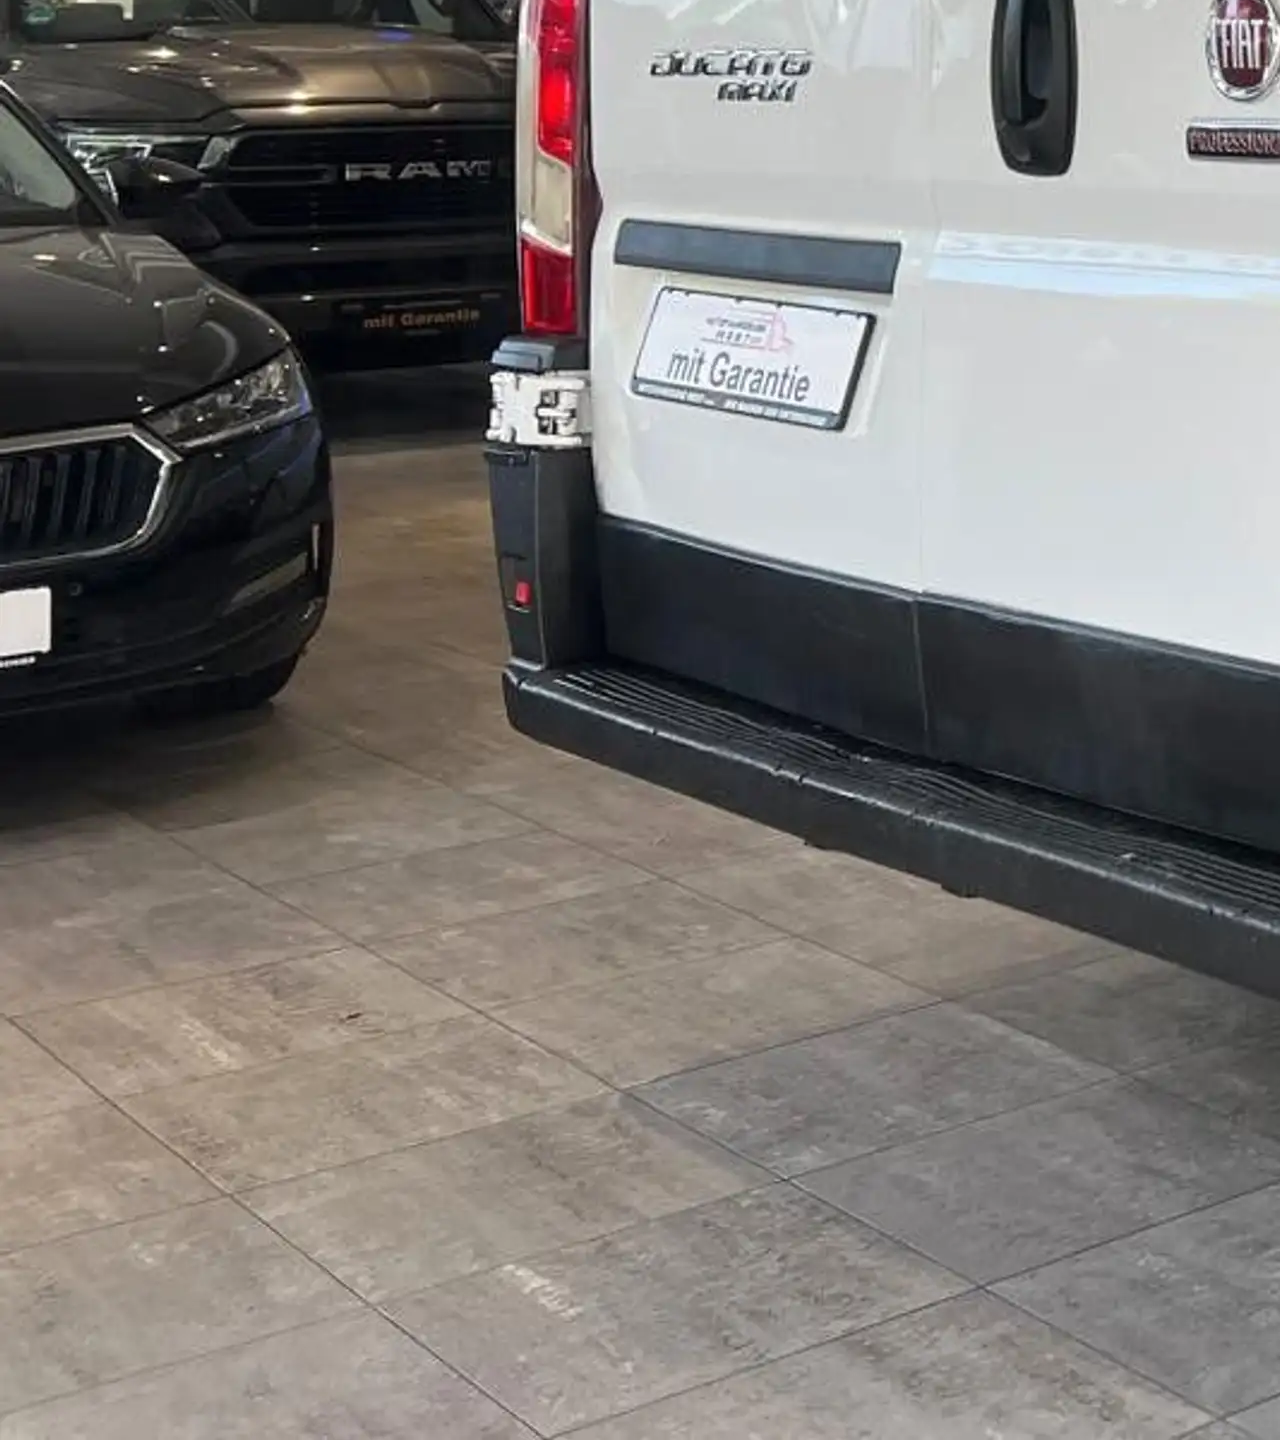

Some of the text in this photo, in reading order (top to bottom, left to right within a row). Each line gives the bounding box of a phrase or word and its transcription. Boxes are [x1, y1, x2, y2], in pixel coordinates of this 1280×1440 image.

[1220, 19, 1265, 69] FIAT
[717, 80, 797, 102] MAXI
[345, 161, 491, 181] RAM
[667, 347, 811, 402] mit Garantie
